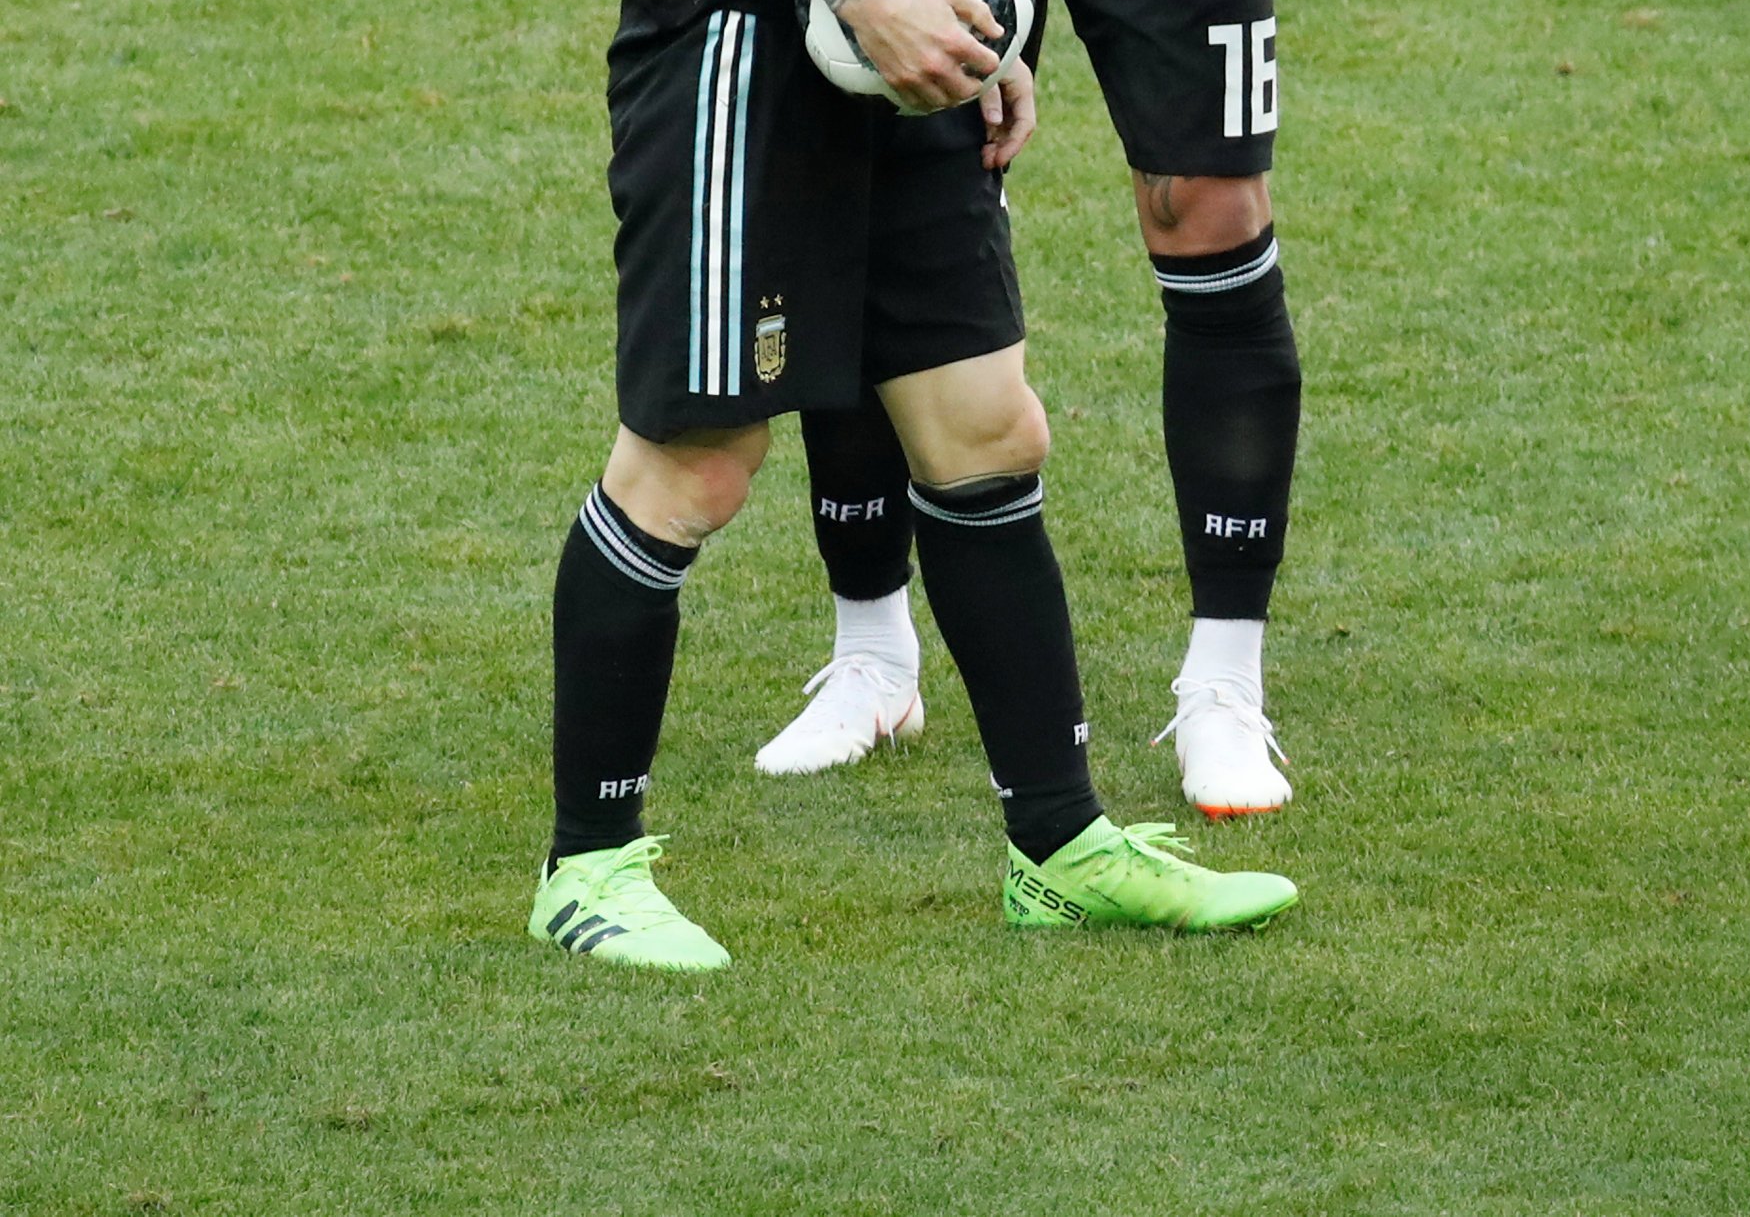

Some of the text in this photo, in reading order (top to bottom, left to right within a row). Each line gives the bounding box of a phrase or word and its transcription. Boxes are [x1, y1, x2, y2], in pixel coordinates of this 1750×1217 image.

[1208, 16, 1279, 138] 16
[820, 497, 885, 522] AFA
[1204, 514, 1267, 538] AFA
[598, 774, 648, 799] AFA
